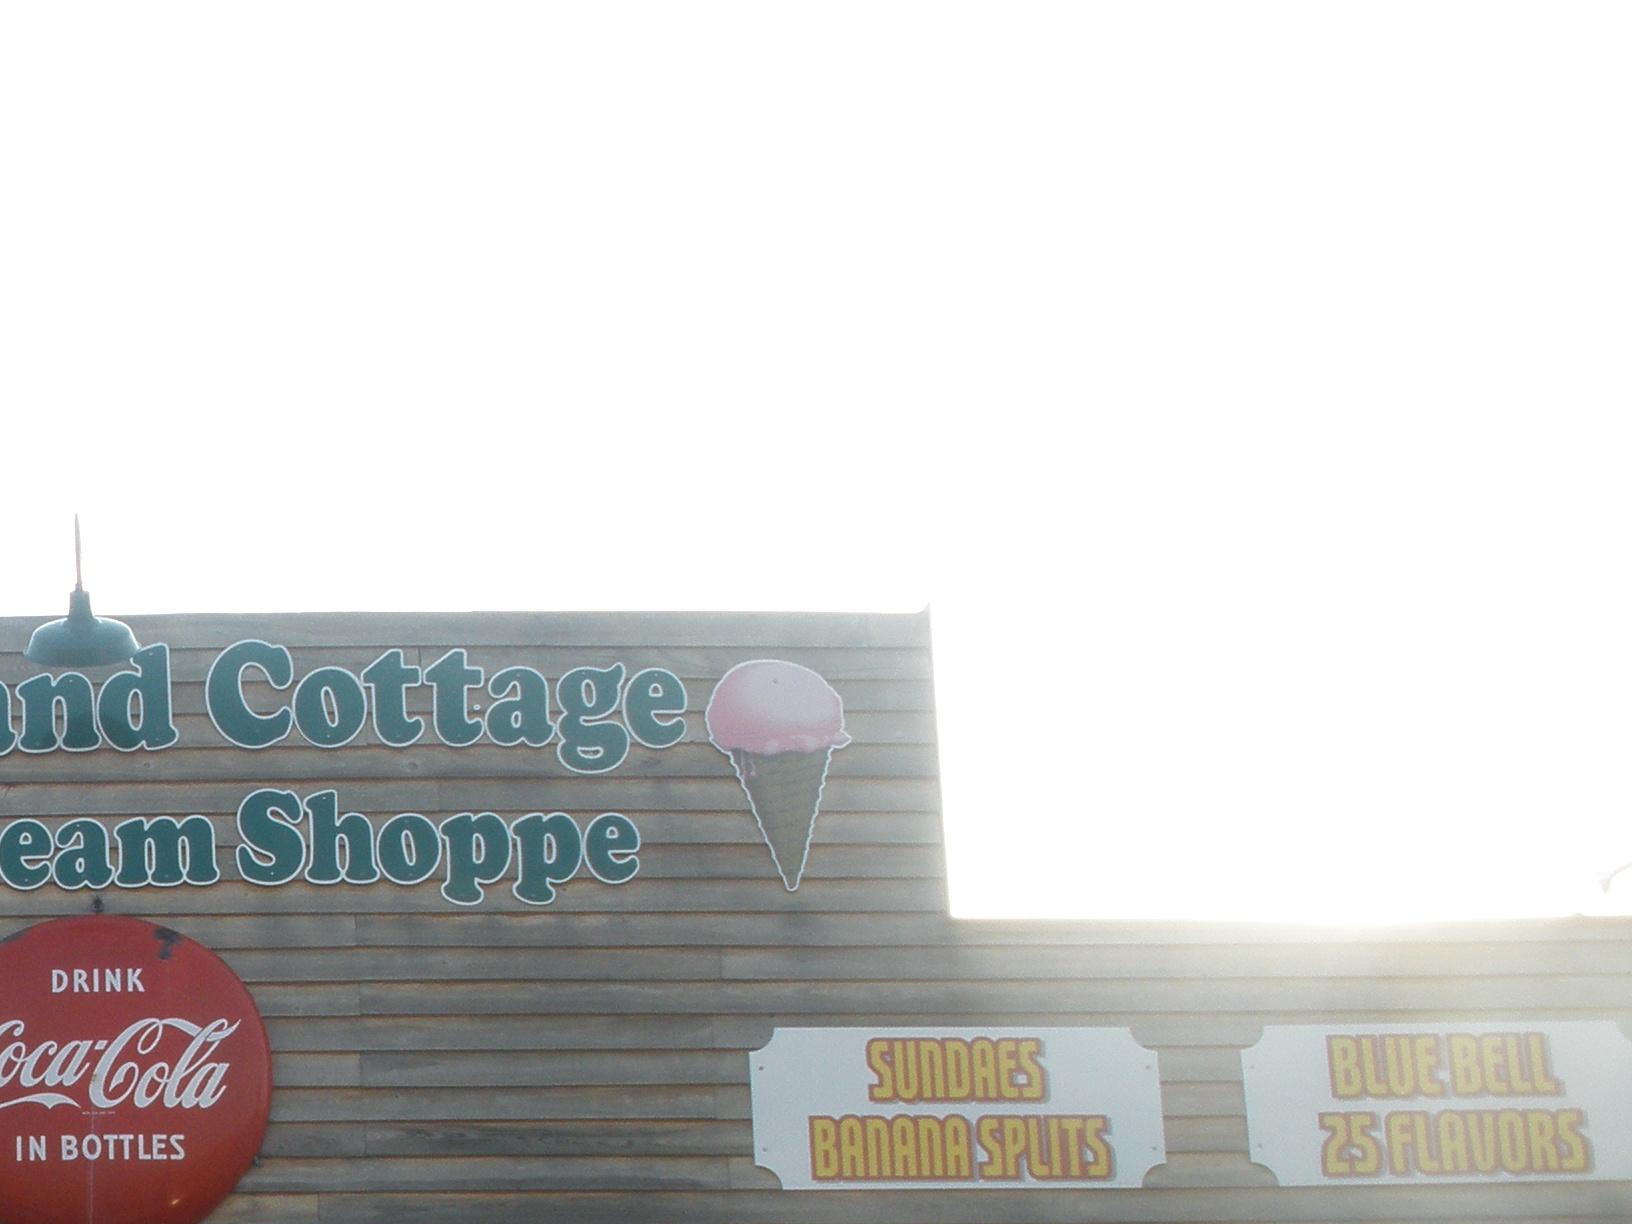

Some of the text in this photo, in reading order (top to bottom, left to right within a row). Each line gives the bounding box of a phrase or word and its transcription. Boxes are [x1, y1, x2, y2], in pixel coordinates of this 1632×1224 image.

[205, 639, 688, 773] Cottage
[235, 789, 640, 905] Shoppe
[51, 968, 145, 993] DRINK
[866, 1037, 1046, 1103] SUNDAES
[1326, 1032, 1564, 1099] BLUE BELL
[16, 1134, 185, 1161] IN BOTTLES
[808, 1114, 1114, 1181] BANANA SPLITS
[1318, 1108, 1592, 1177] 25 FLAVORS
